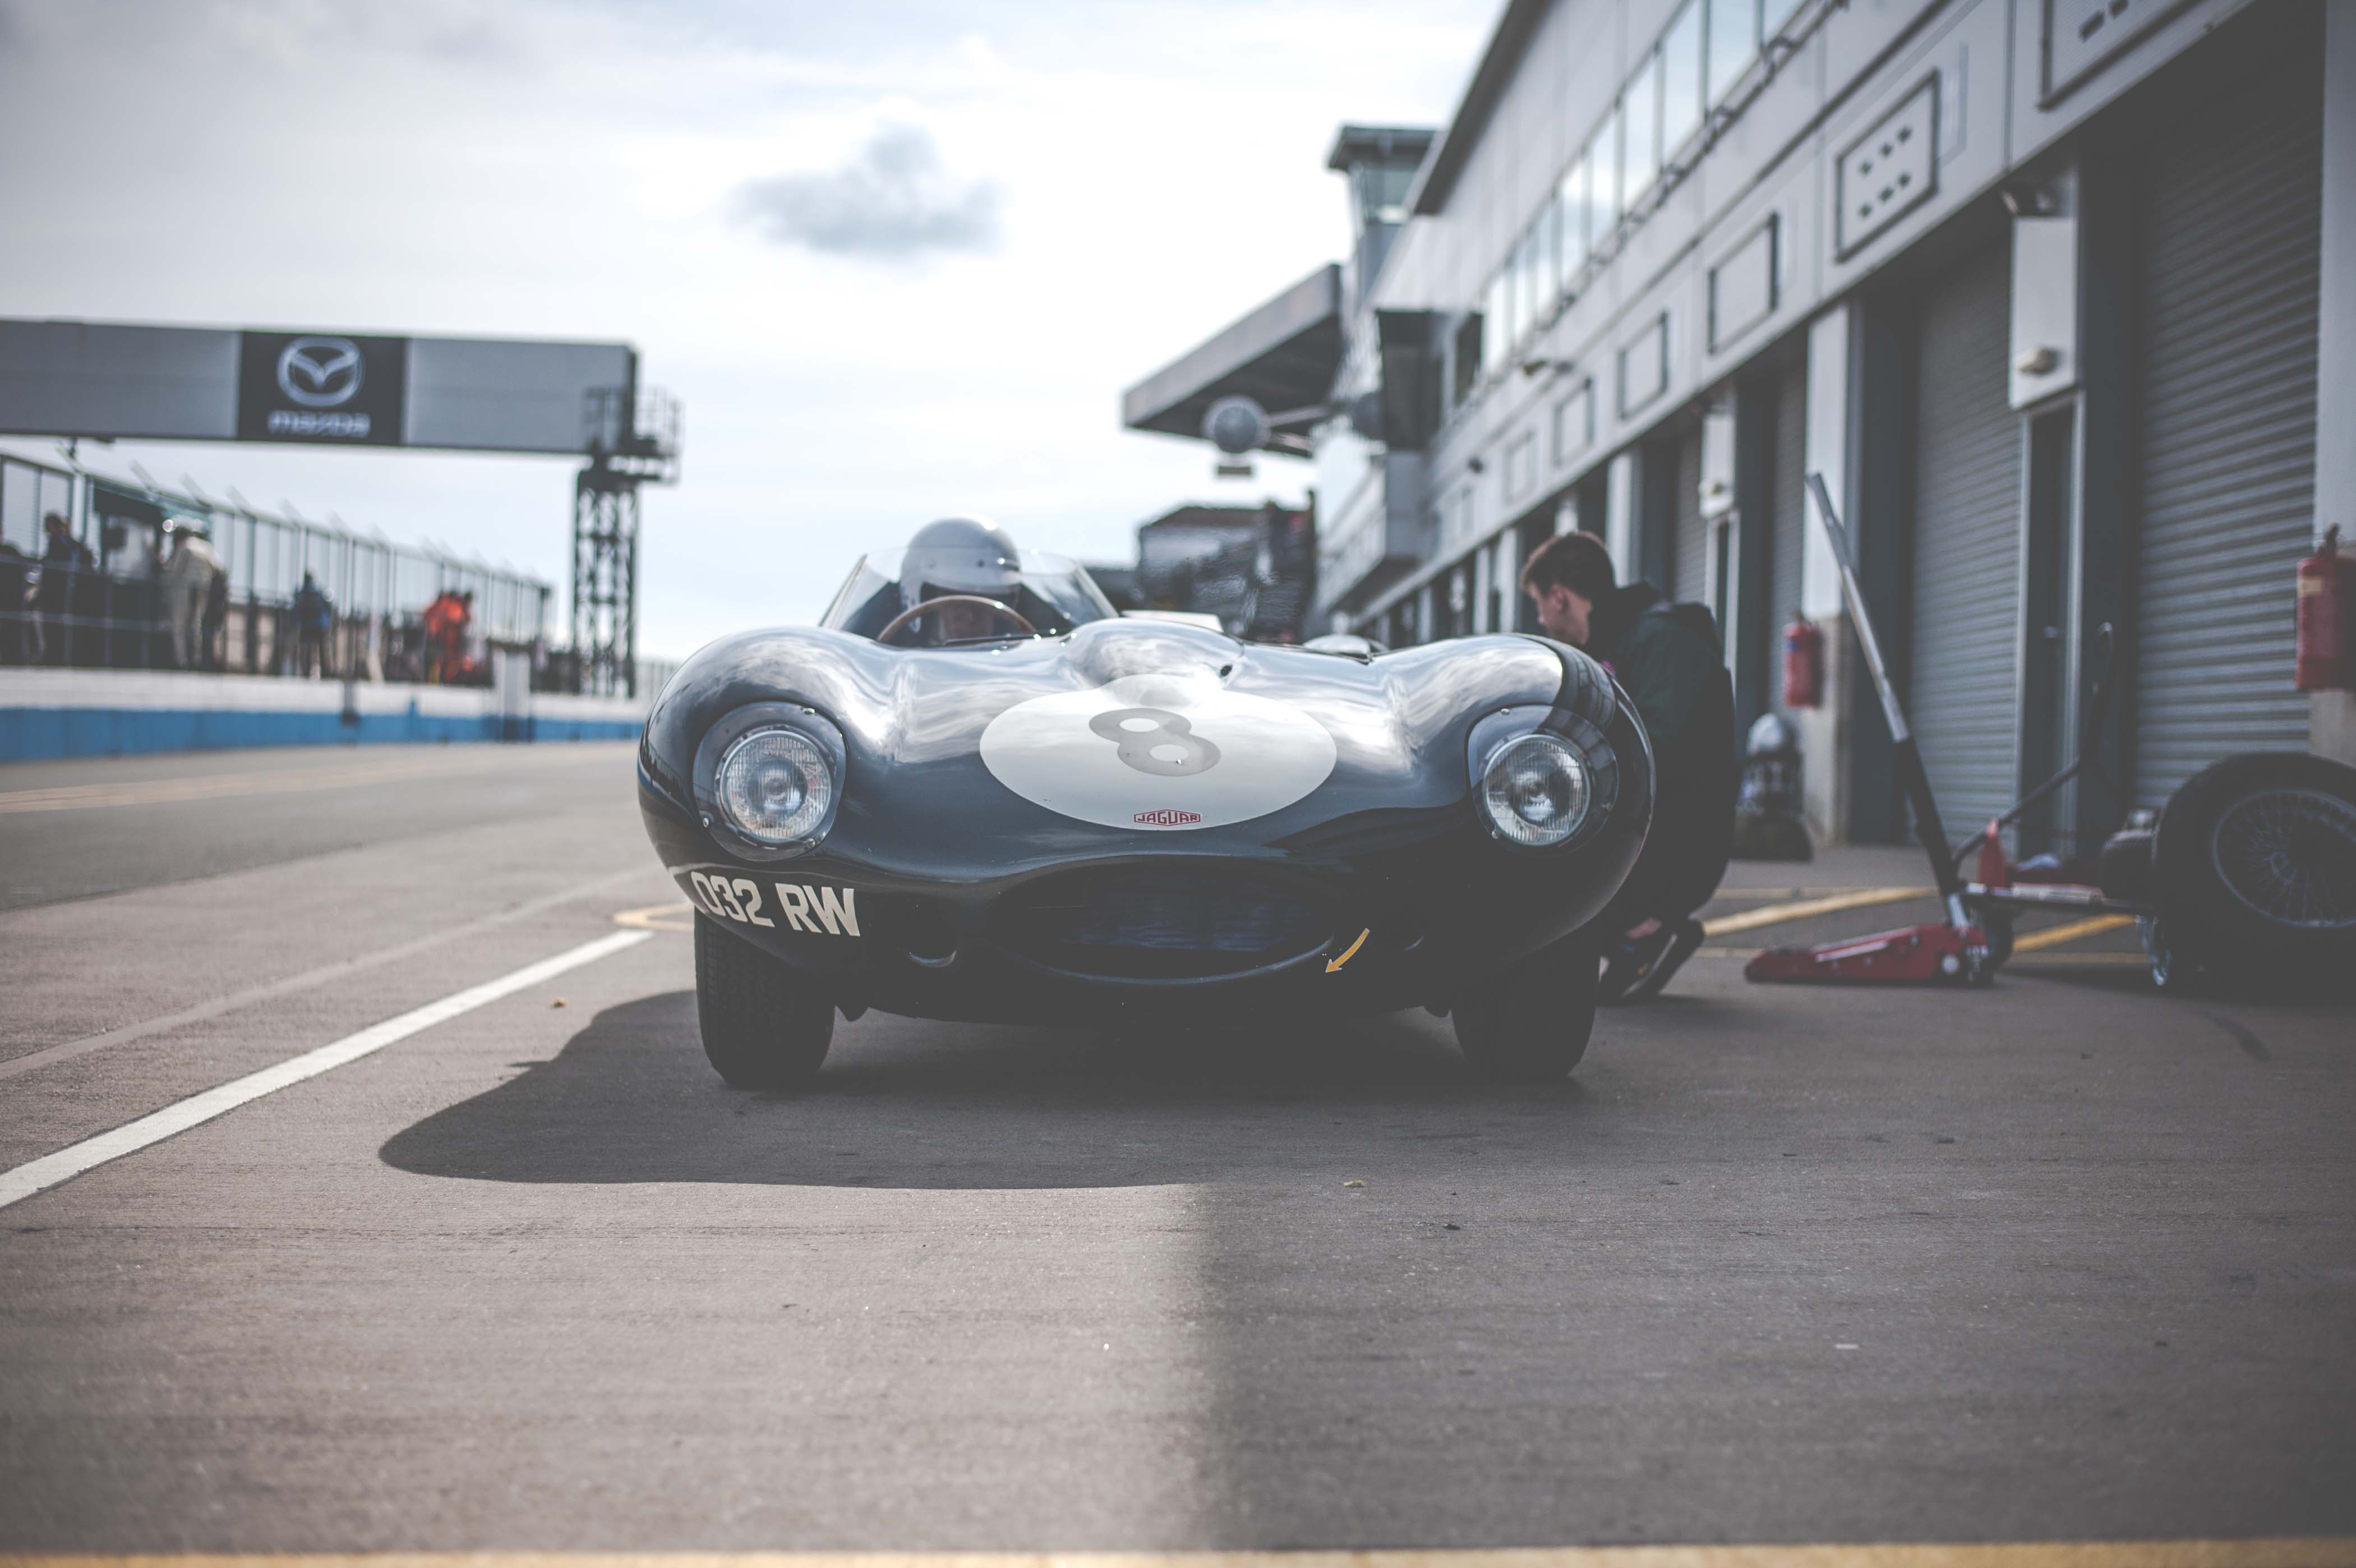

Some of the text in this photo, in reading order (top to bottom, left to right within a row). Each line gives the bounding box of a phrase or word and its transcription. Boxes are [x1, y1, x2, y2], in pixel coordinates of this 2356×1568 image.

[1089, 708, 1221, 776] 8
[1137, 811, 1198, 824] JAGUAR
[775, 883, 860, 936] RW
